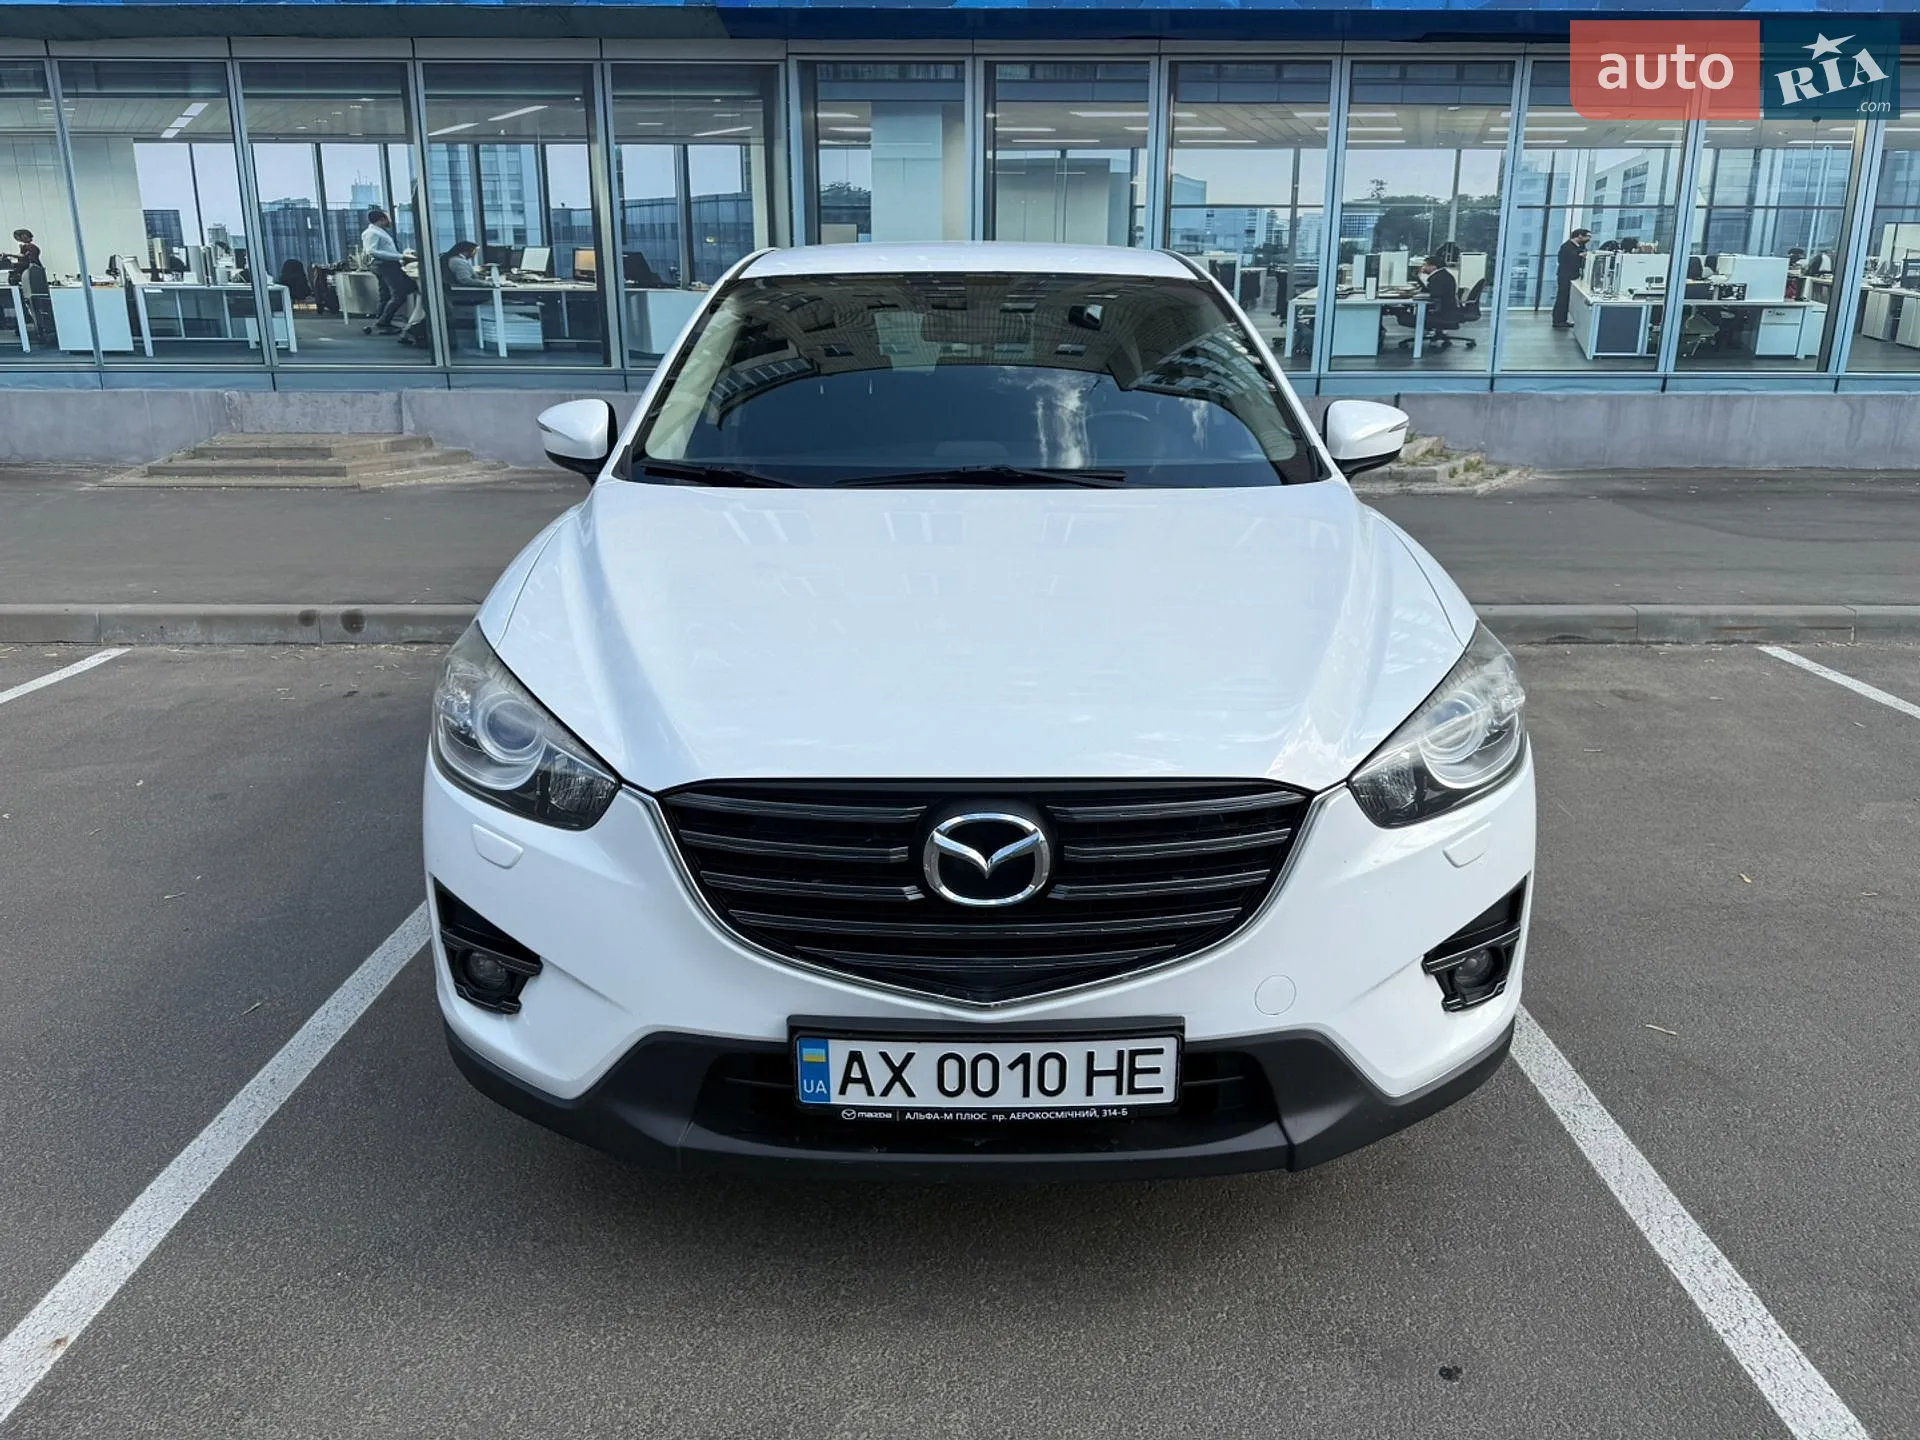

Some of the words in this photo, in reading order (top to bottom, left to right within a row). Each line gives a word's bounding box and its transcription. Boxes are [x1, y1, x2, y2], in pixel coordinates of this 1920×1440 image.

[838, 1050, 916, 1098] AX
[936, 1051, 1067, 1098] 0010
[1086, 1047, 1165, 1096] HE
[803, 1079, 828, 1095] UA
[857, 1111, 892, 1119] mazda
[905, 1112, 953, 1121] АЛЬФА-М
[956, 1112, 988, 1121] ПЛЮС
